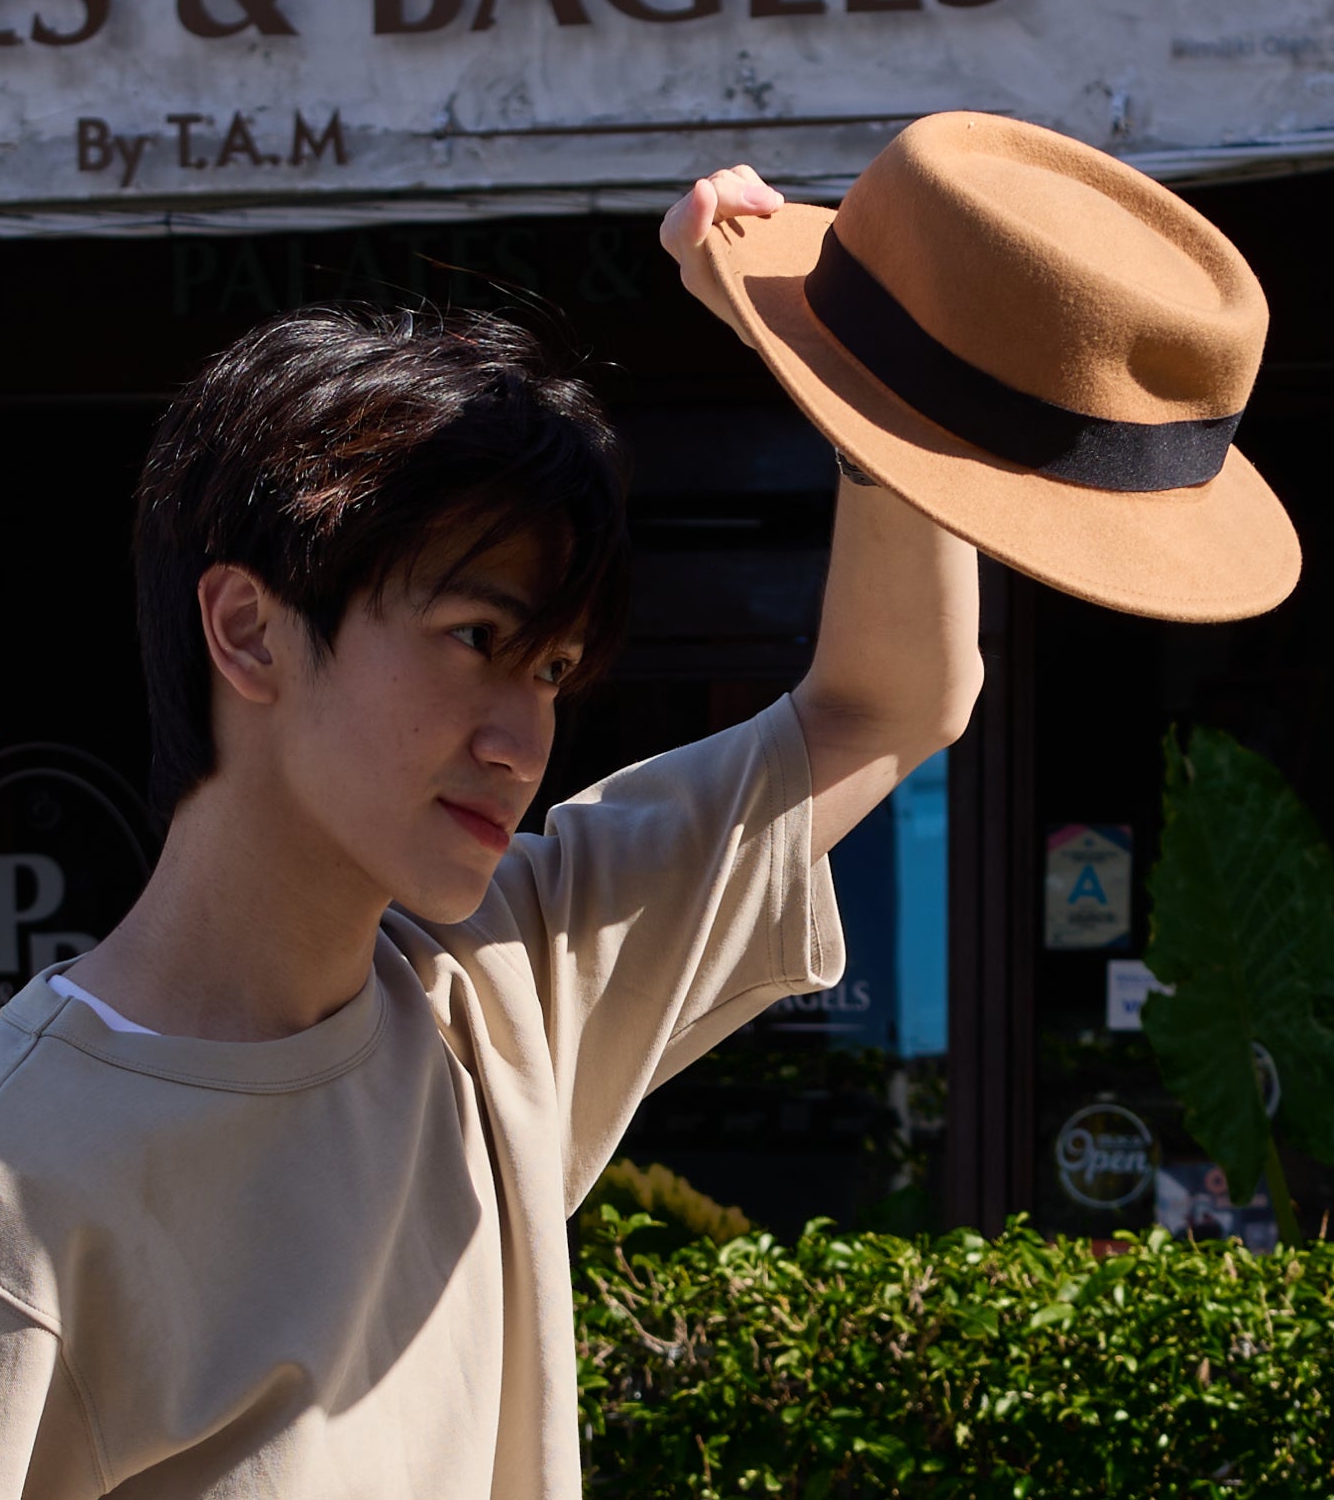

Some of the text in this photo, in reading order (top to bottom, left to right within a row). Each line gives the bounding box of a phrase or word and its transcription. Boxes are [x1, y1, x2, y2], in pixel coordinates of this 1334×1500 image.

[77, 115, 151, 188] By
[578, 223, 648, 303] &
[1068, 865, 1107, 905] A
[1056, 1129, 1149, 1186] Open
